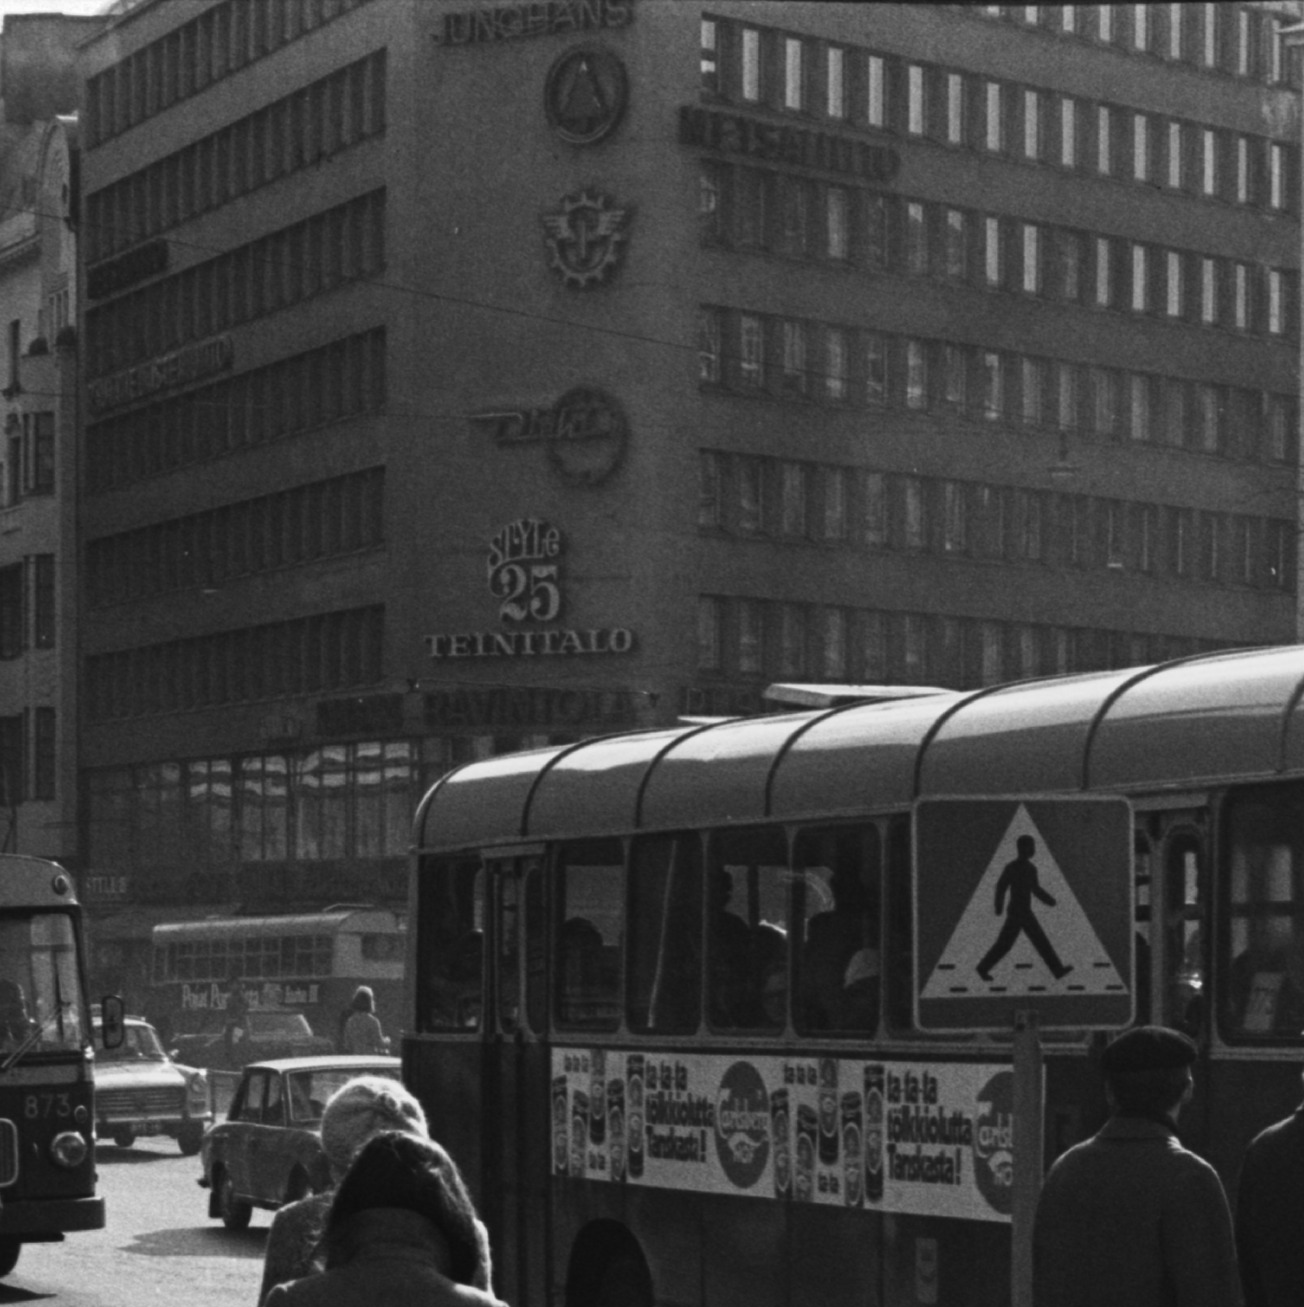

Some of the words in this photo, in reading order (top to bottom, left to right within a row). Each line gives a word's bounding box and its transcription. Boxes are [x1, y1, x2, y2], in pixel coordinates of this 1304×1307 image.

[429, 0, 632, 46] JUNGHANS
[489, 564, 561, 621] 25
[424, 628, 632, 657] TEINITALO
[23, 1093, 70, 1119] 873
[887, 1105, 972, 1145] tölkkiolutta
[645, 1125, 707, 1163] Tanskasta!
[887, 1143, 961, 1186] Tanskasta!
